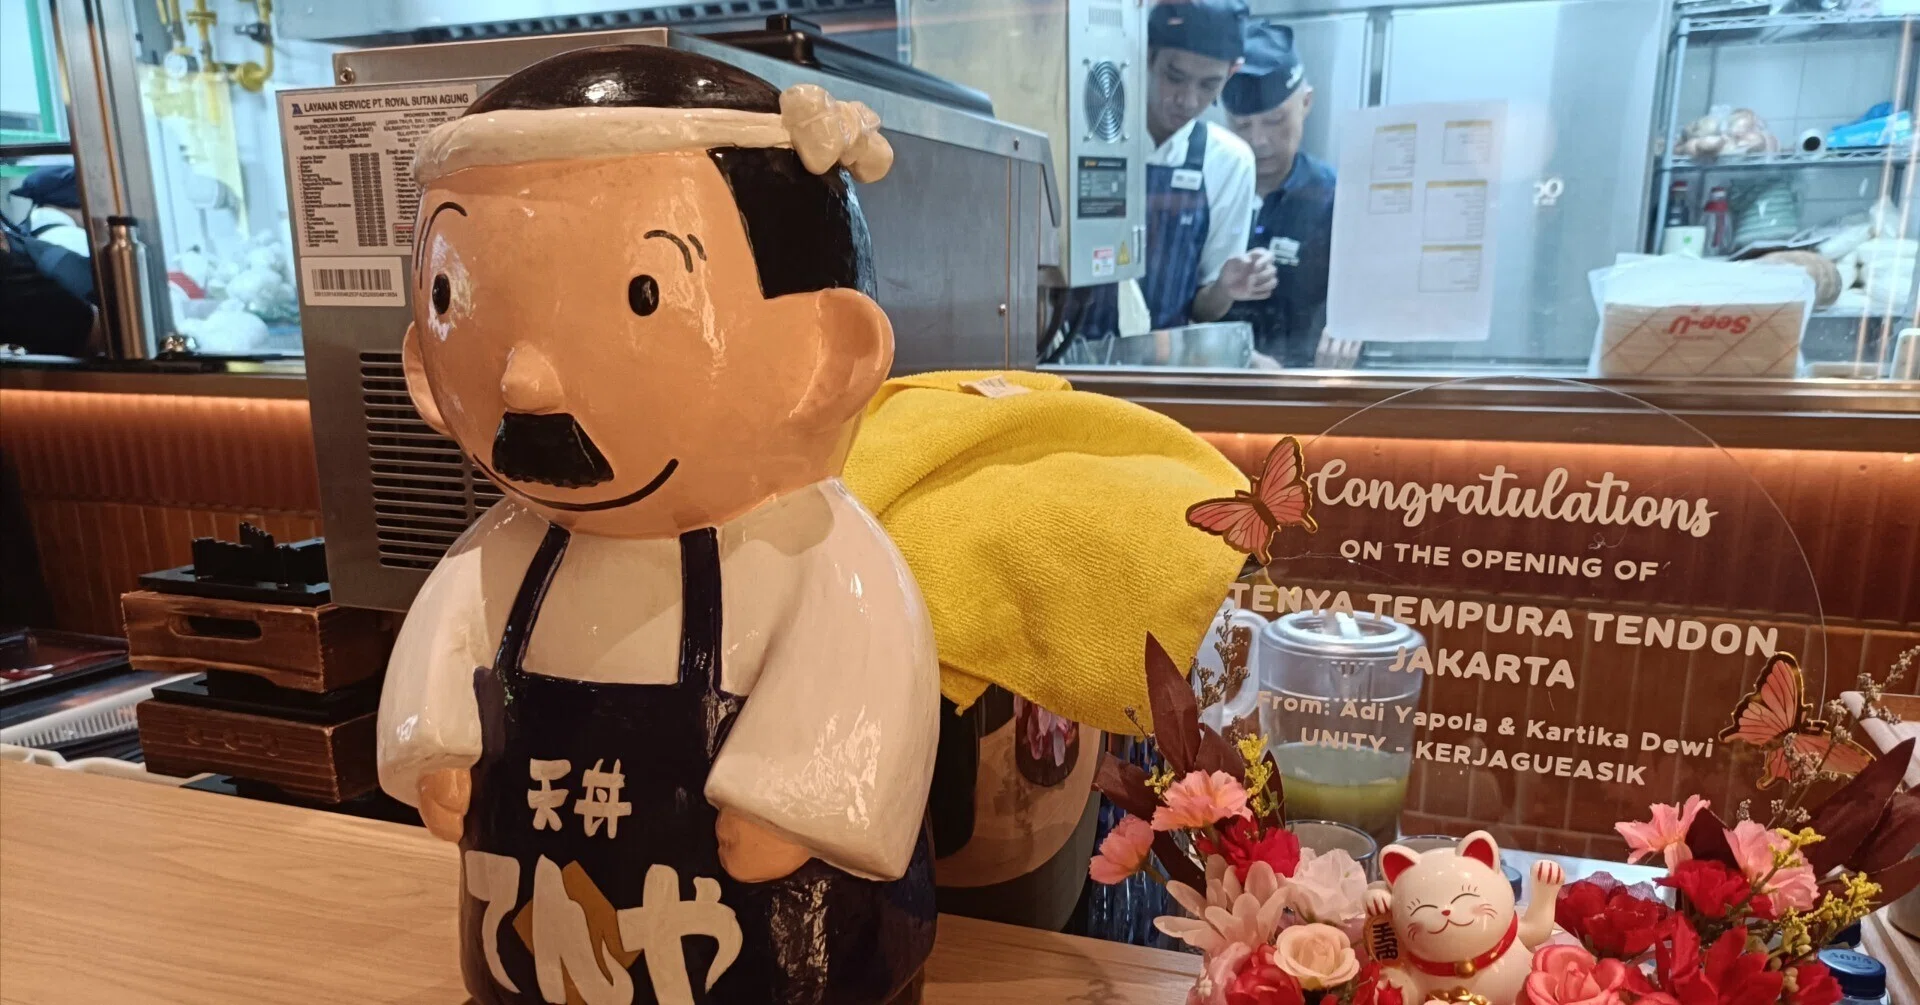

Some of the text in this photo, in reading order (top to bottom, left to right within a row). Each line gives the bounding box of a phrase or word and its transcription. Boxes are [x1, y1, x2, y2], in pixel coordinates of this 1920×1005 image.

[304, 93, 469, 113] LAYANAN SERVICE PT. ROYAL SUTAN AGUNG
[1307, 458, 1719, 538] Congratulations
[1340, 539, 1659, 581] ON THE OPENING OF
[1227, 582, 1778, 657] TENYA TEMPURA TENDON
[1388, 645, 1576, 689] JAKARTA
[1257, 690, 1714, 759] From: Adi Yapola & Kartika Dewi
[1301, 728, 1388, 753] UNITY
[1416, 741, 1647, 786] KERJAGUEASIK
[527, 758, 632, 839] 天丼
[464, 849, 743, 1005] てんや
